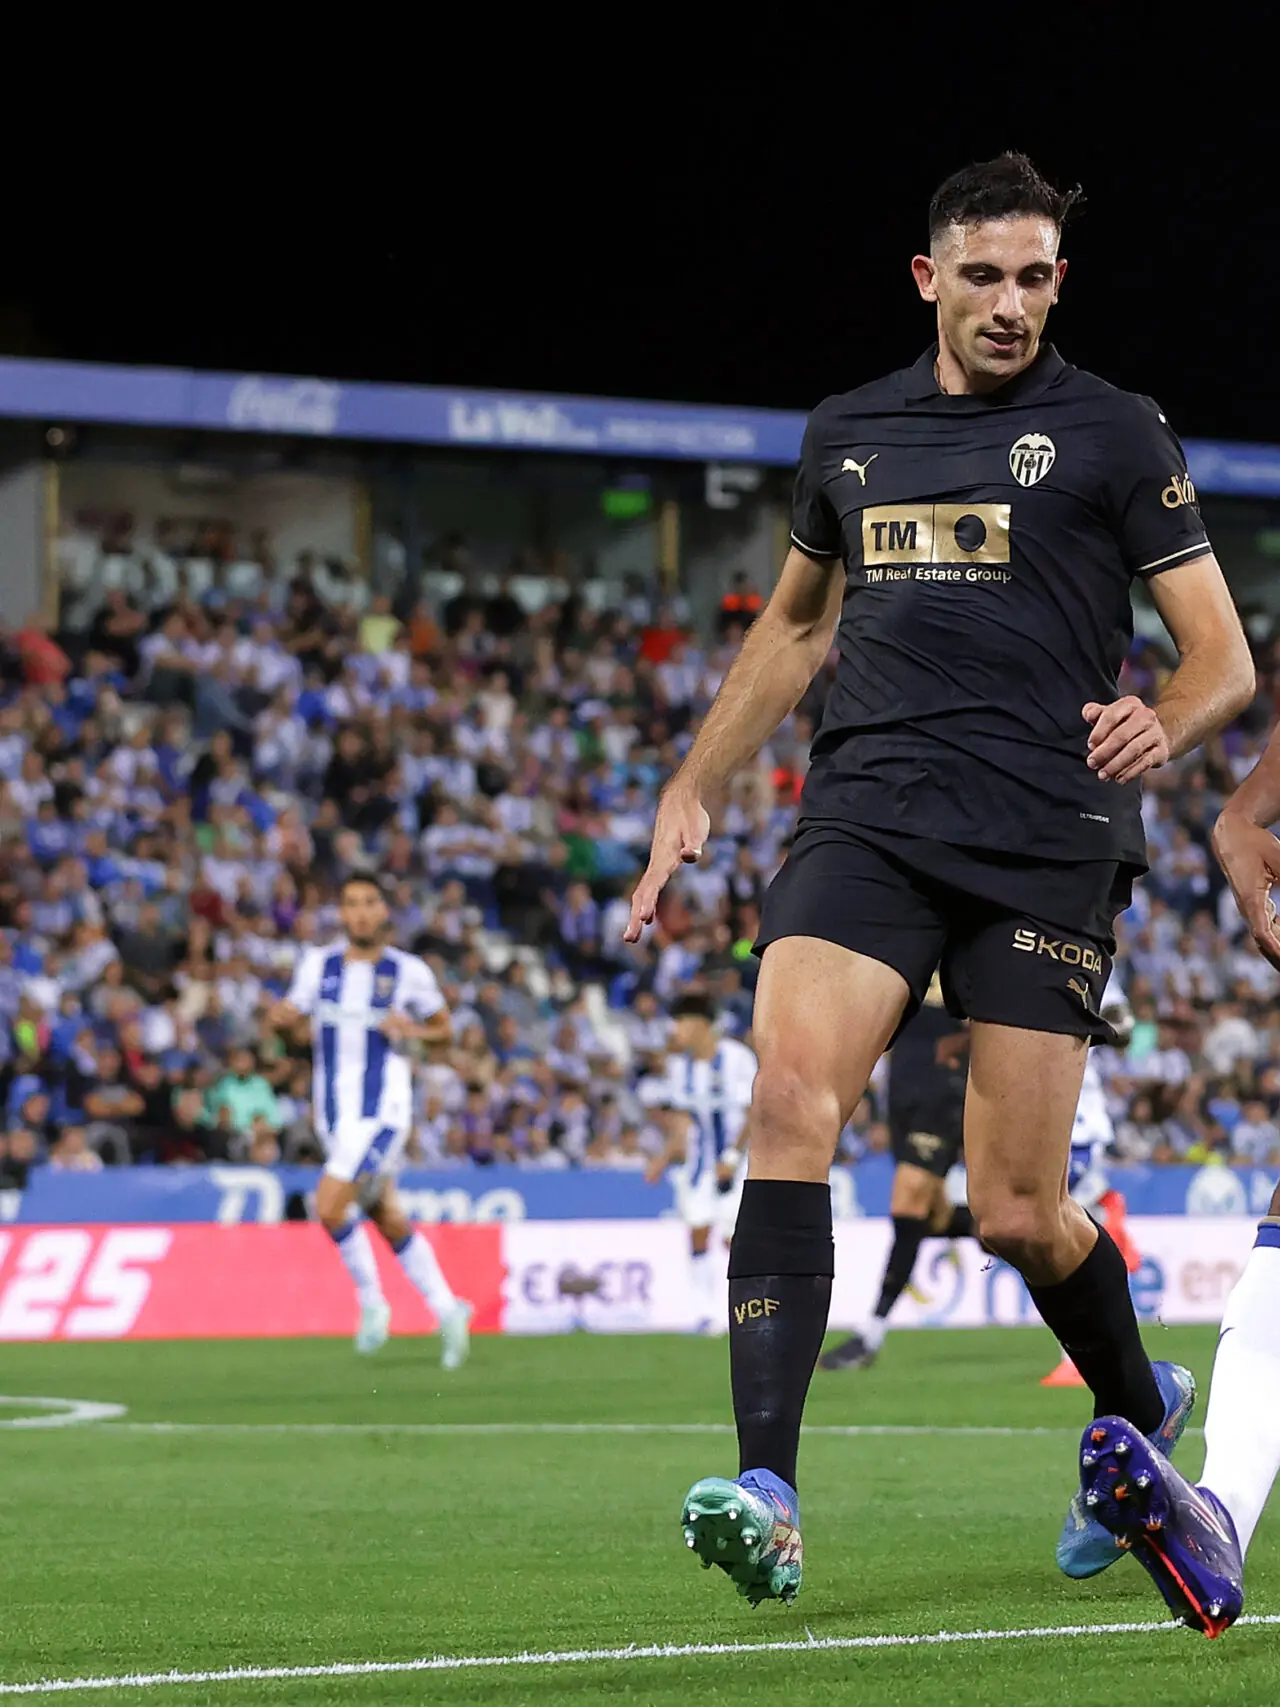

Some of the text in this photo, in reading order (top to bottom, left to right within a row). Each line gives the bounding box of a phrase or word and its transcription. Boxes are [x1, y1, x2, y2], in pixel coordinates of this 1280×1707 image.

[871, 521, 917, 551] TM
[866, 568, 1012, 584] TM Real Estate Group
[0, 1227, 174, 1338] 25
[734, 1298, 780, 1324] VCF
